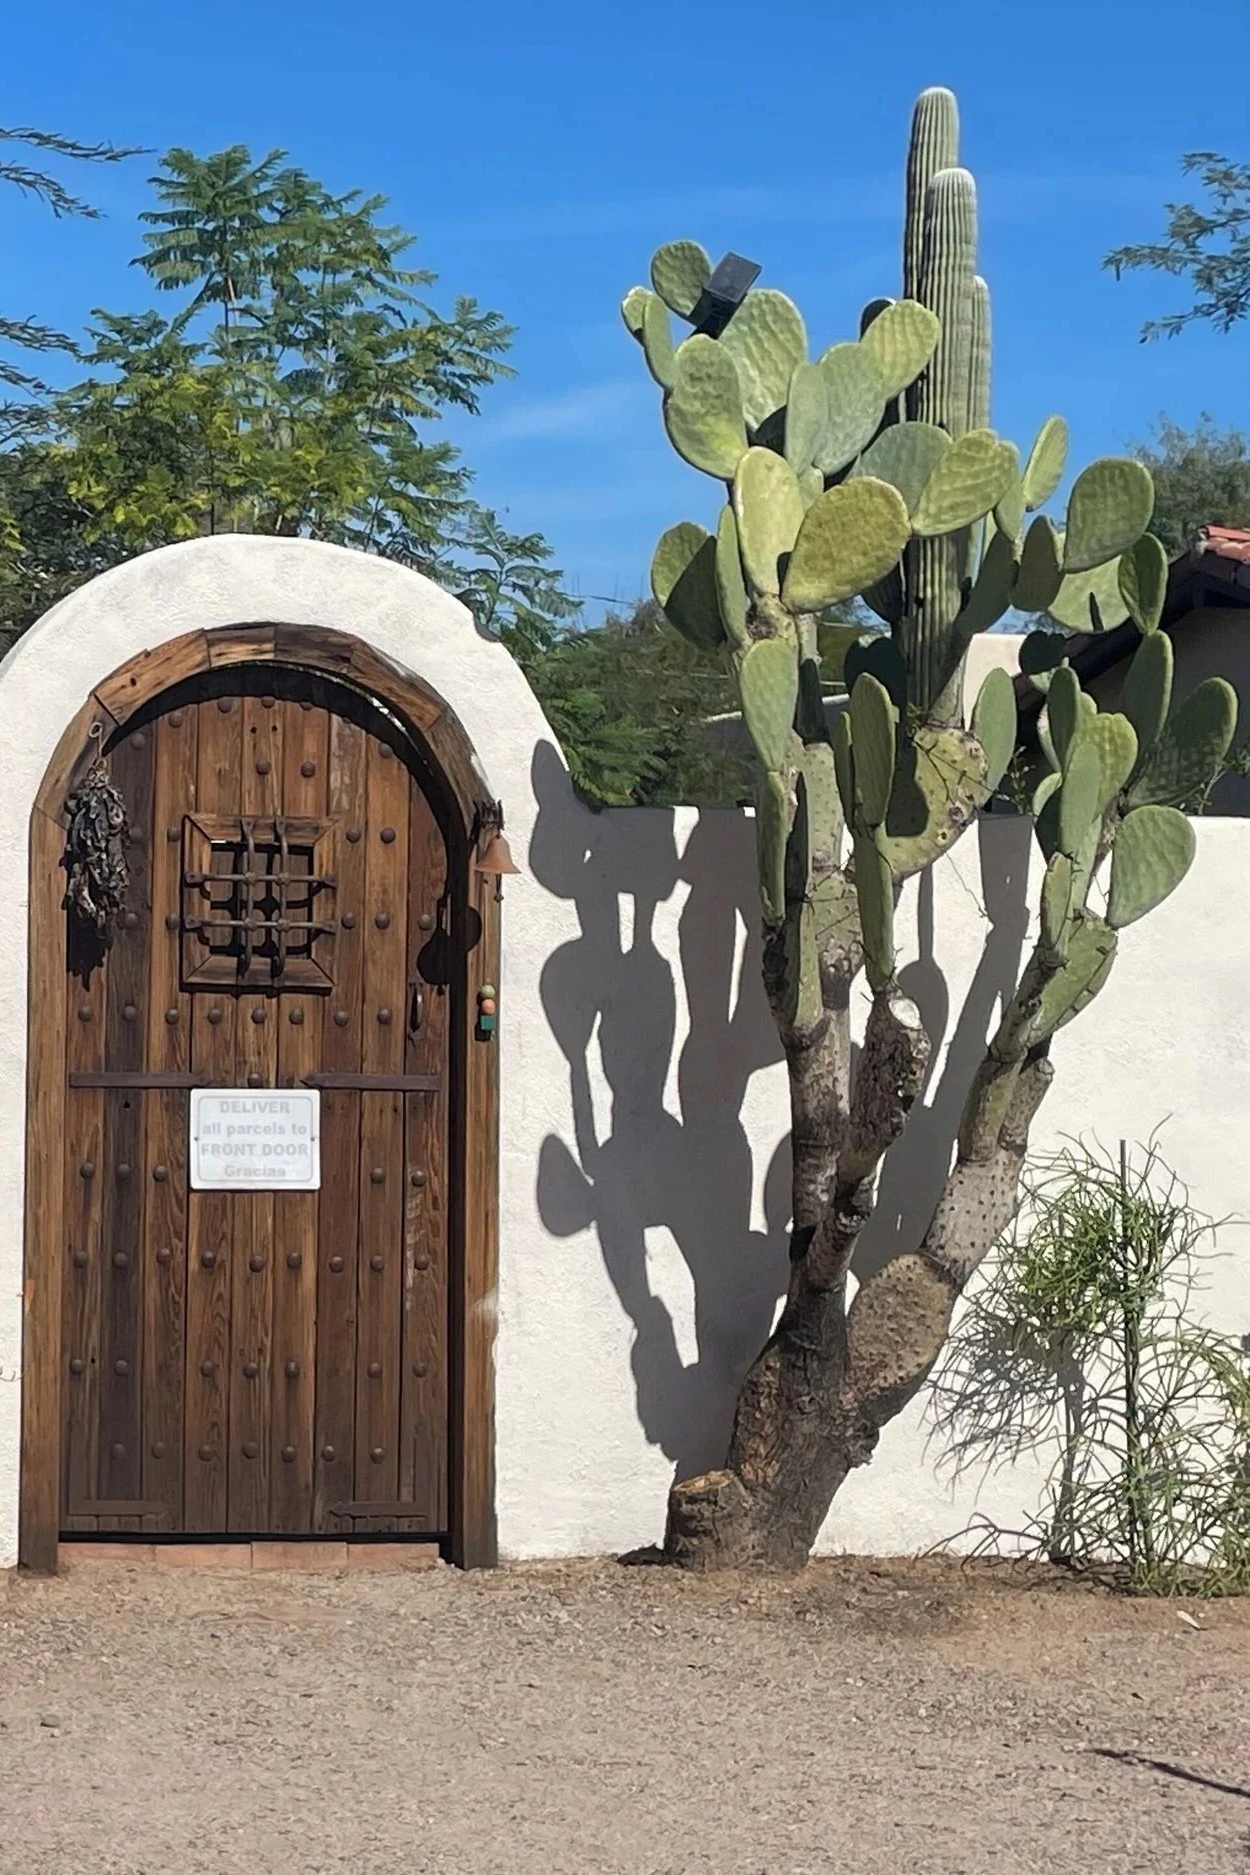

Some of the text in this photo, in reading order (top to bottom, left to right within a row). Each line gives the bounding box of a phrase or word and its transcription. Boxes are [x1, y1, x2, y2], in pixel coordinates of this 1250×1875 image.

[220, 1100, 290, 1114] DELIVER
[202, 1121, 307, 1138] all parcels to
[201, 1143, 309, 1156] FRONT DOOR
[224, 1164, 286, 1177] Gracias
